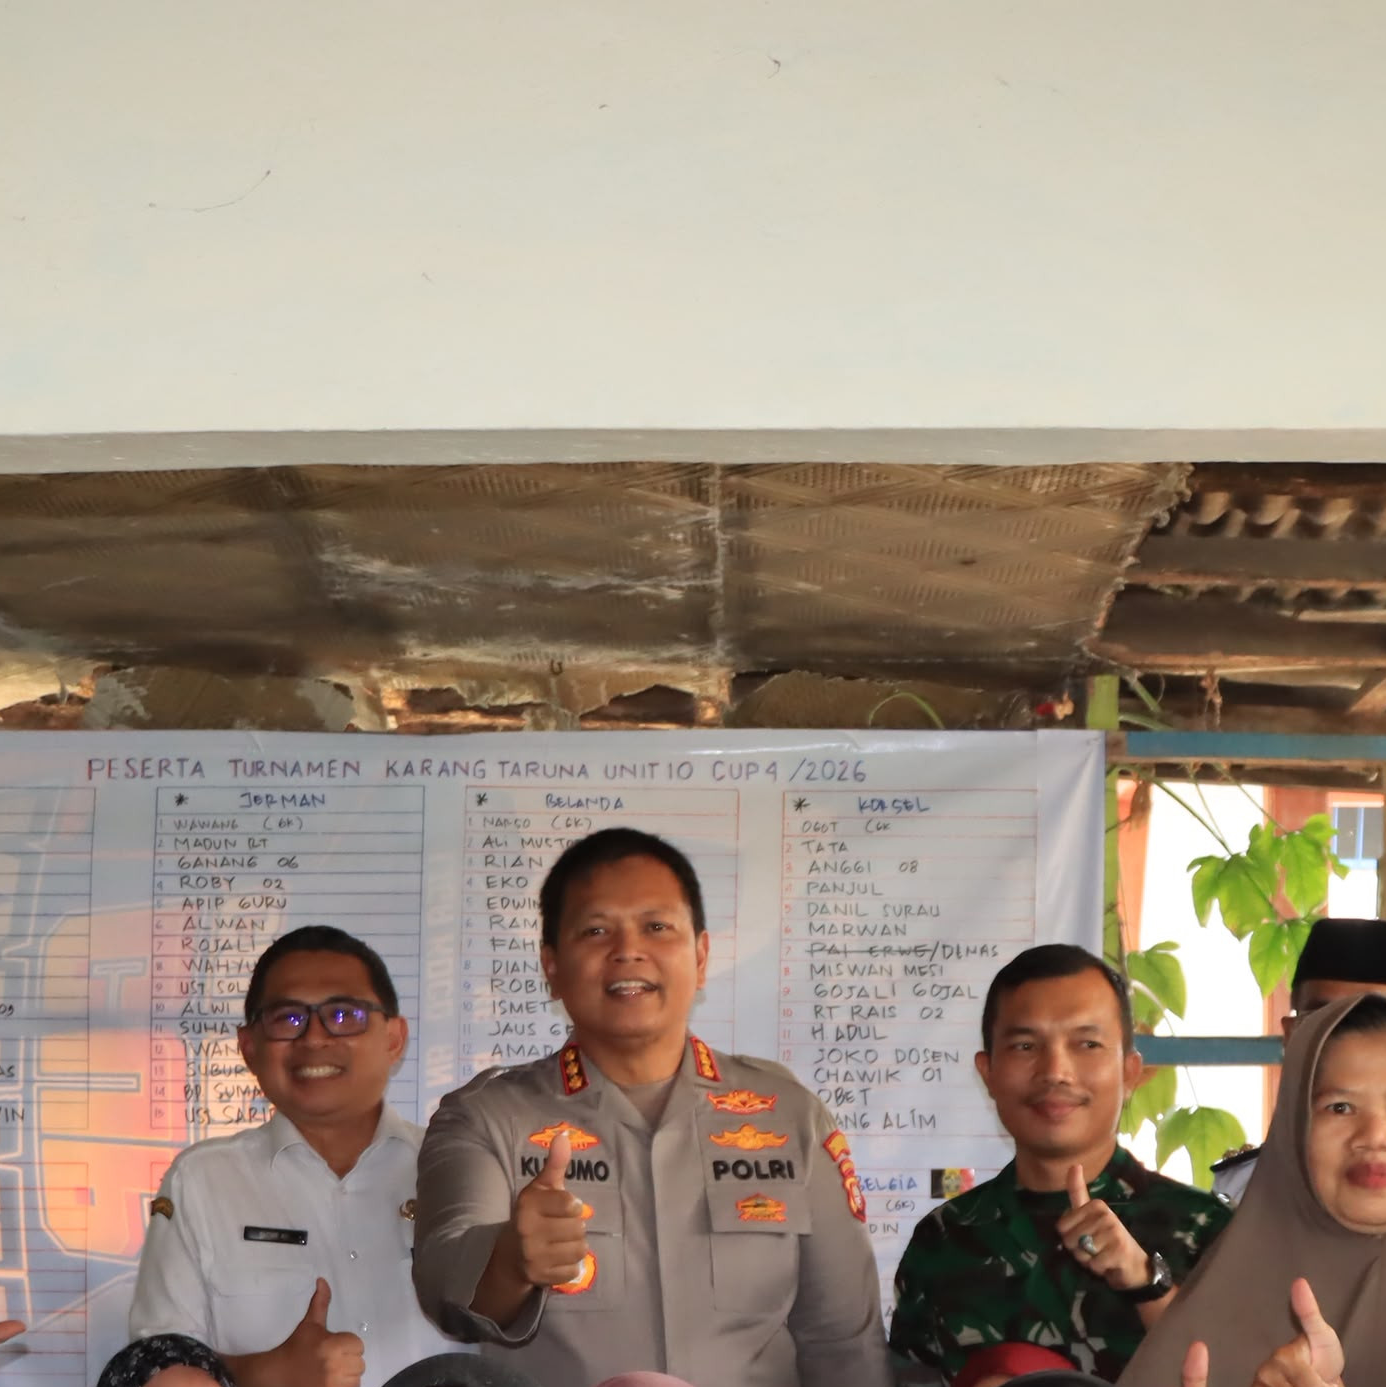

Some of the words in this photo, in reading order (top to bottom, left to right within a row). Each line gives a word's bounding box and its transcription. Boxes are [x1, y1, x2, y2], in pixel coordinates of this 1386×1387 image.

[87, 758, 205, 781] PESERTA
[229, 758, 361, 779] TURNAMEN
[385, 758, 487, 779] KARANG
[497, 760, 589, 779] TARUNA
[603, 761, 660, 780] UNIT
[239, 791, 326, 809] JERMAN
[545, 792, 625, 810] BELANDA
[173, 836, 238, 851] MADUN
[801, 840, 850, 855] TATA
[276, 855, 300, 869] 06
[484, 855, 544, 869] RIAN
[897, 861, 919, 873] 08
[179, 874, 237, 891] ROBY
[262, 877, 285, 890] 02
[485, 875, 529, 889] EKO
[806, 881, 885, 897] PANJUL
[181, 896, 225, 911] APIP
[806, 902, 869, 918] DANIL
[882, 902, 941, 918] SURAU
[182, 915, 266, 931] ALWAN
[808, 922, 907, 938] MARWAN
[180, 937, 257, 953] ROJALI
[181, 958, 257, 974] WAHYU
[492, 959, 540, 975] DIAN
[809, 962, 894, 979] MISWAN
[903, 963, 945, 978] MESI
[180, 1002, 231, 1016] ALWI
[492, 1000, 552, 1016] ISMET
[813, 1005, 835, 1020] RT
[850, 1004, 898, 1020] RAIS
[919, 1005, 945, 1020] 02
[488, 1020, 537, 1037] JAUS
[835, 1024, 889, 1042] ADUL
[813, 1048, 879, 1065] JOKO
[894, 1048, 960, 1065] DOSEN
[813, 1066, 902, 1084] CHAWIK
[921, 1067, 943, 1083] 01
[520, 1155, 611, 1183] KUUMO
[713, 1158, 795, 1182] POLRI
